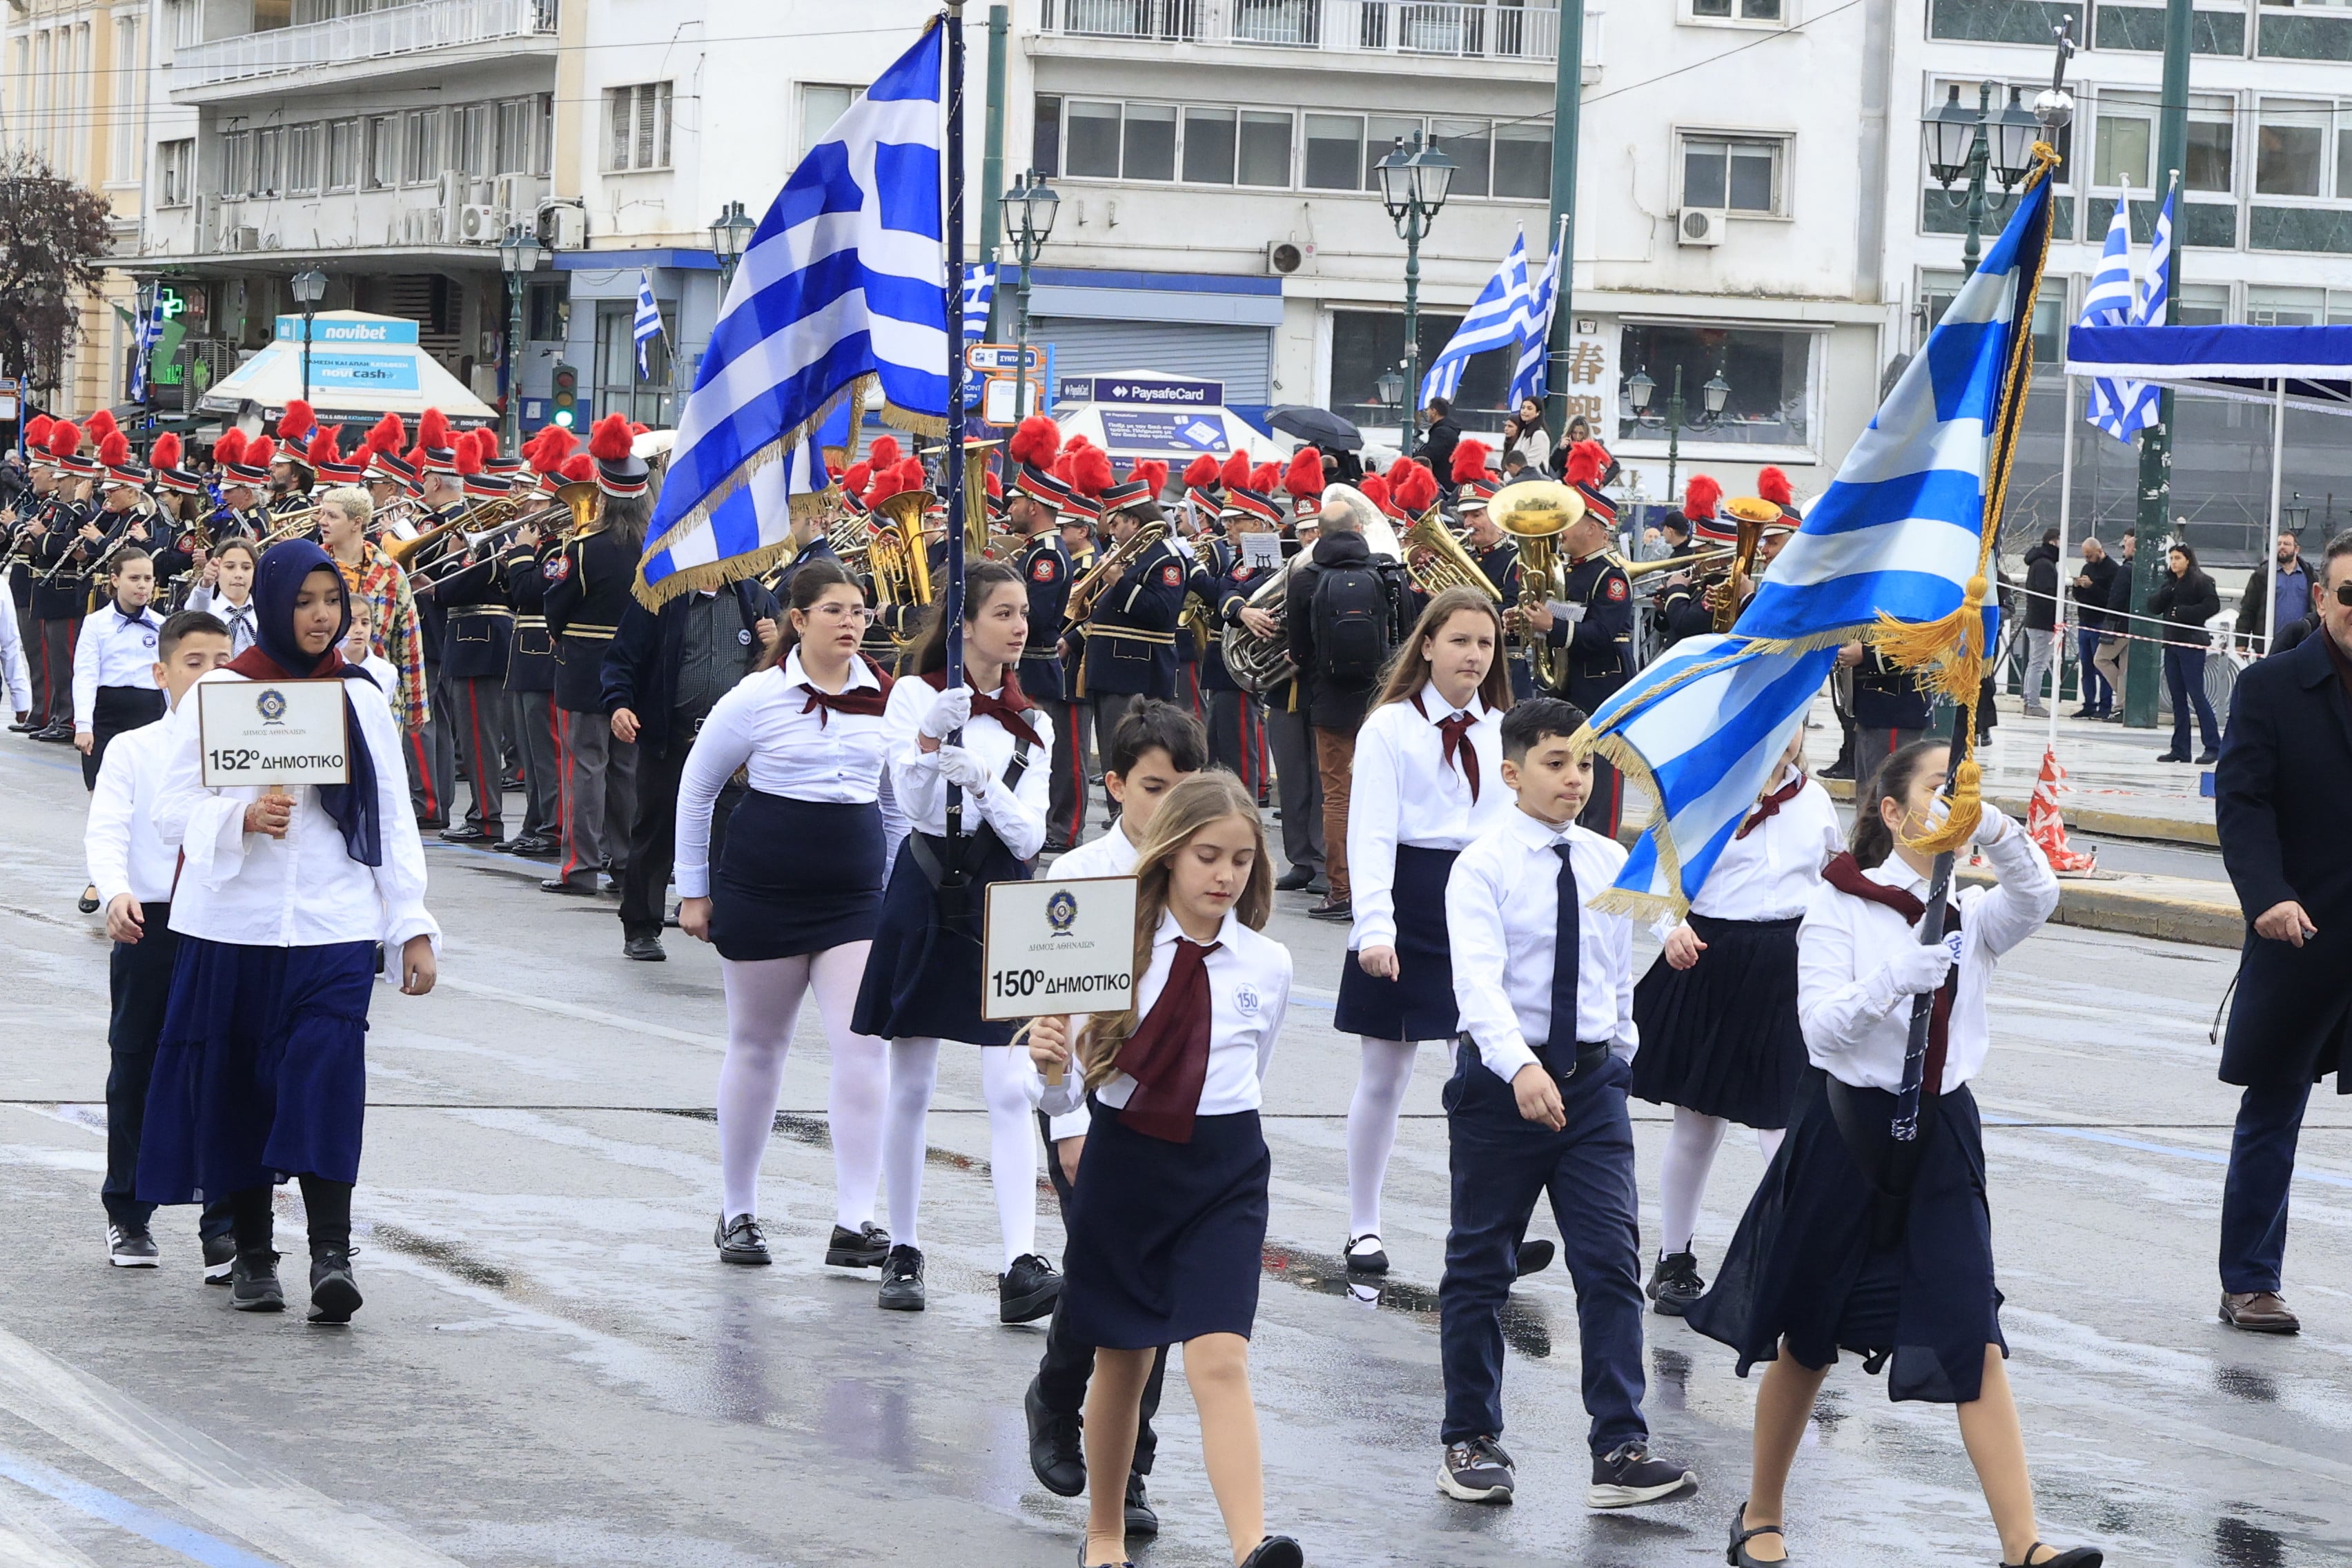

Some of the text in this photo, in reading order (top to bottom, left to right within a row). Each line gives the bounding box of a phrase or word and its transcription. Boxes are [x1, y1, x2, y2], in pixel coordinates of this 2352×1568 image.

[325, 324, 386, 340] novibet
[1000, 355, 1032, 363] ΣΥΝΤΑΑ
[322, 367, 386, 379] novicash
[1132, 386, 1204, 402] PaysafeCard
[262, 754, 344, 769] ΔΗΜΟΤΙΚΟ
[1028, 941, 1095, 952] ΔΗΜΟΣ ΑΘΗΝΑΙΩΝ
[1045, 973, 1130, 994] ΔΗΜΟΤΙΚΟ
[1237, 992, 1258, 1008] 150
